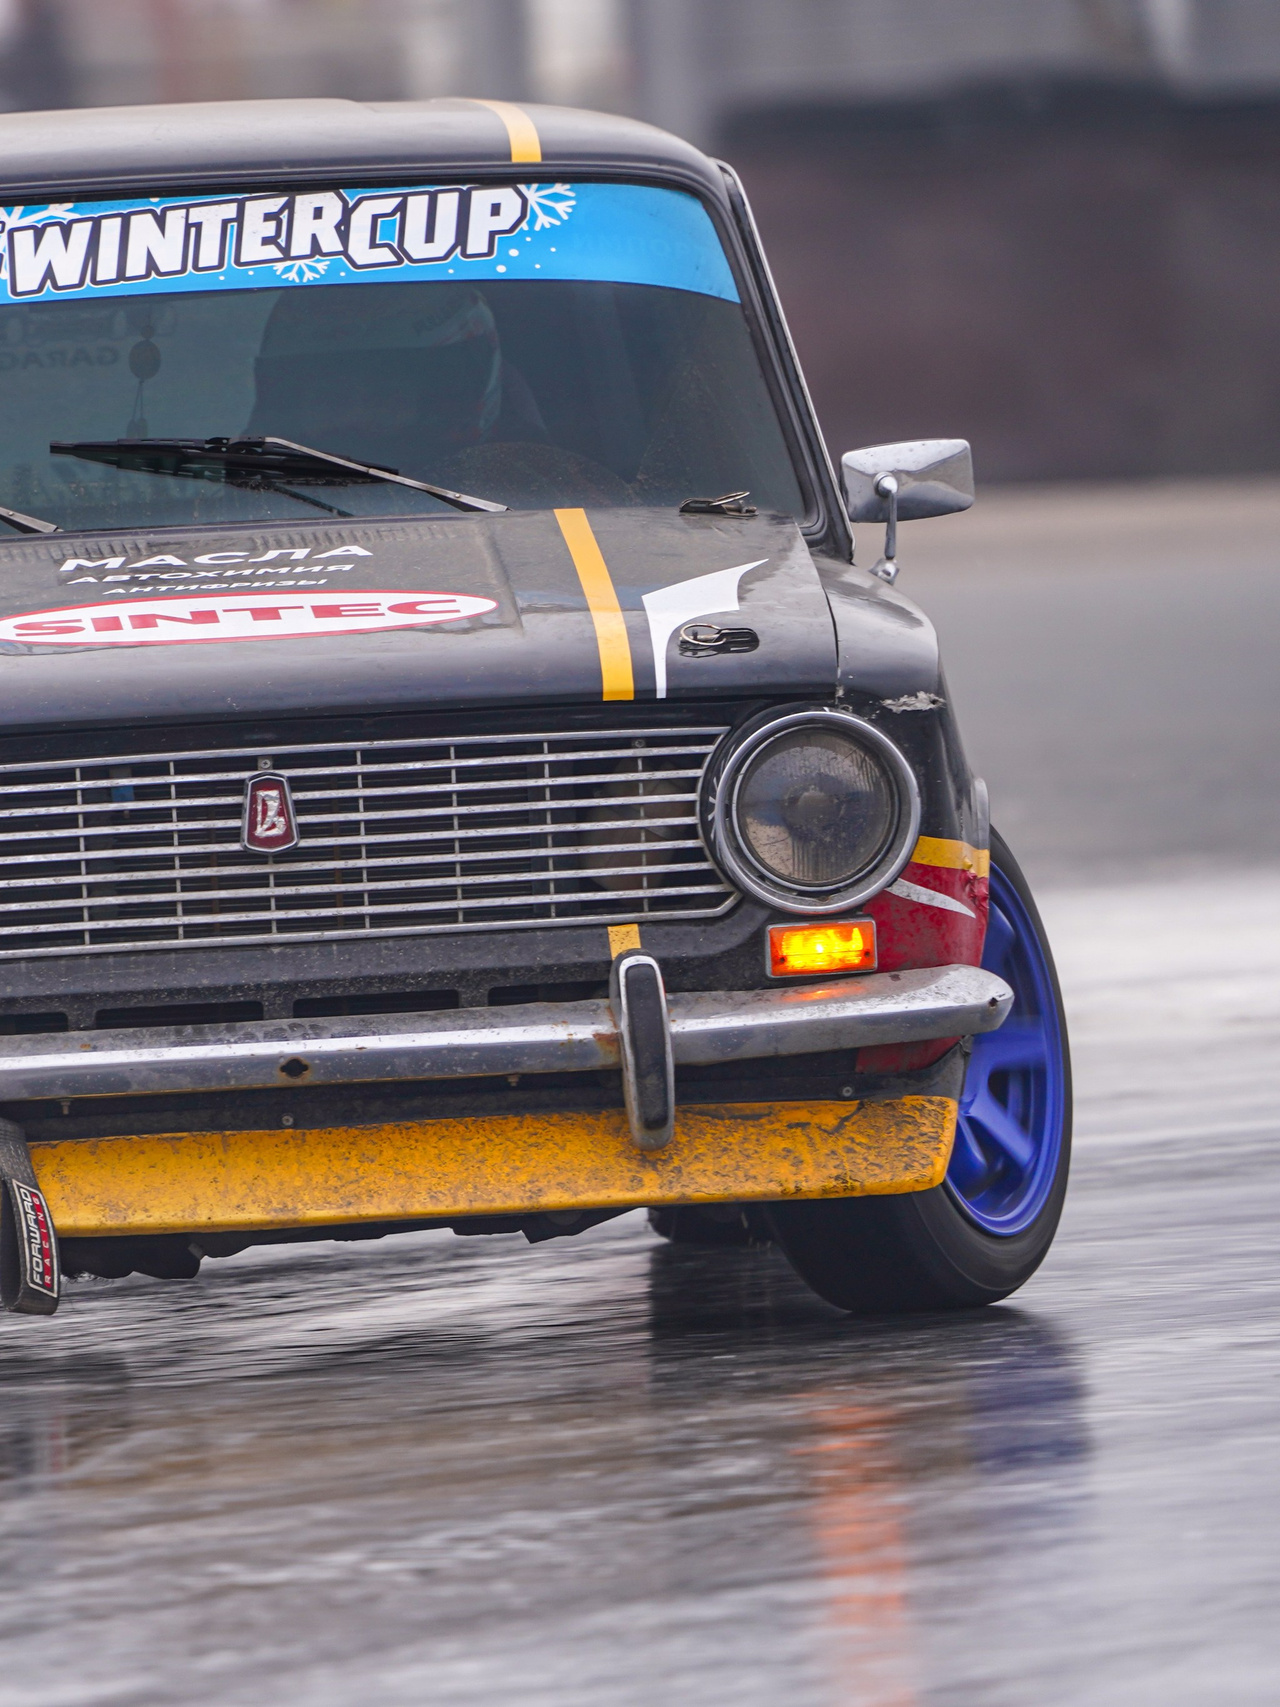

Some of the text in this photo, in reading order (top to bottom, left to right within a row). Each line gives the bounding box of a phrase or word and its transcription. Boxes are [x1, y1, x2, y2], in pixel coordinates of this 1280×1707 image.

[58, 545, 374, 572] МАСЛА
[65, 564, 355, 585] АВТОХИМИЯ
[102, 578, 328, 595] АНТИФРИЗЫ
[14, 598, 462, 638] SINTEC
[19, 1188, 43, 1285] FORWARD
[31, 1196, 52, 1285] RACING
